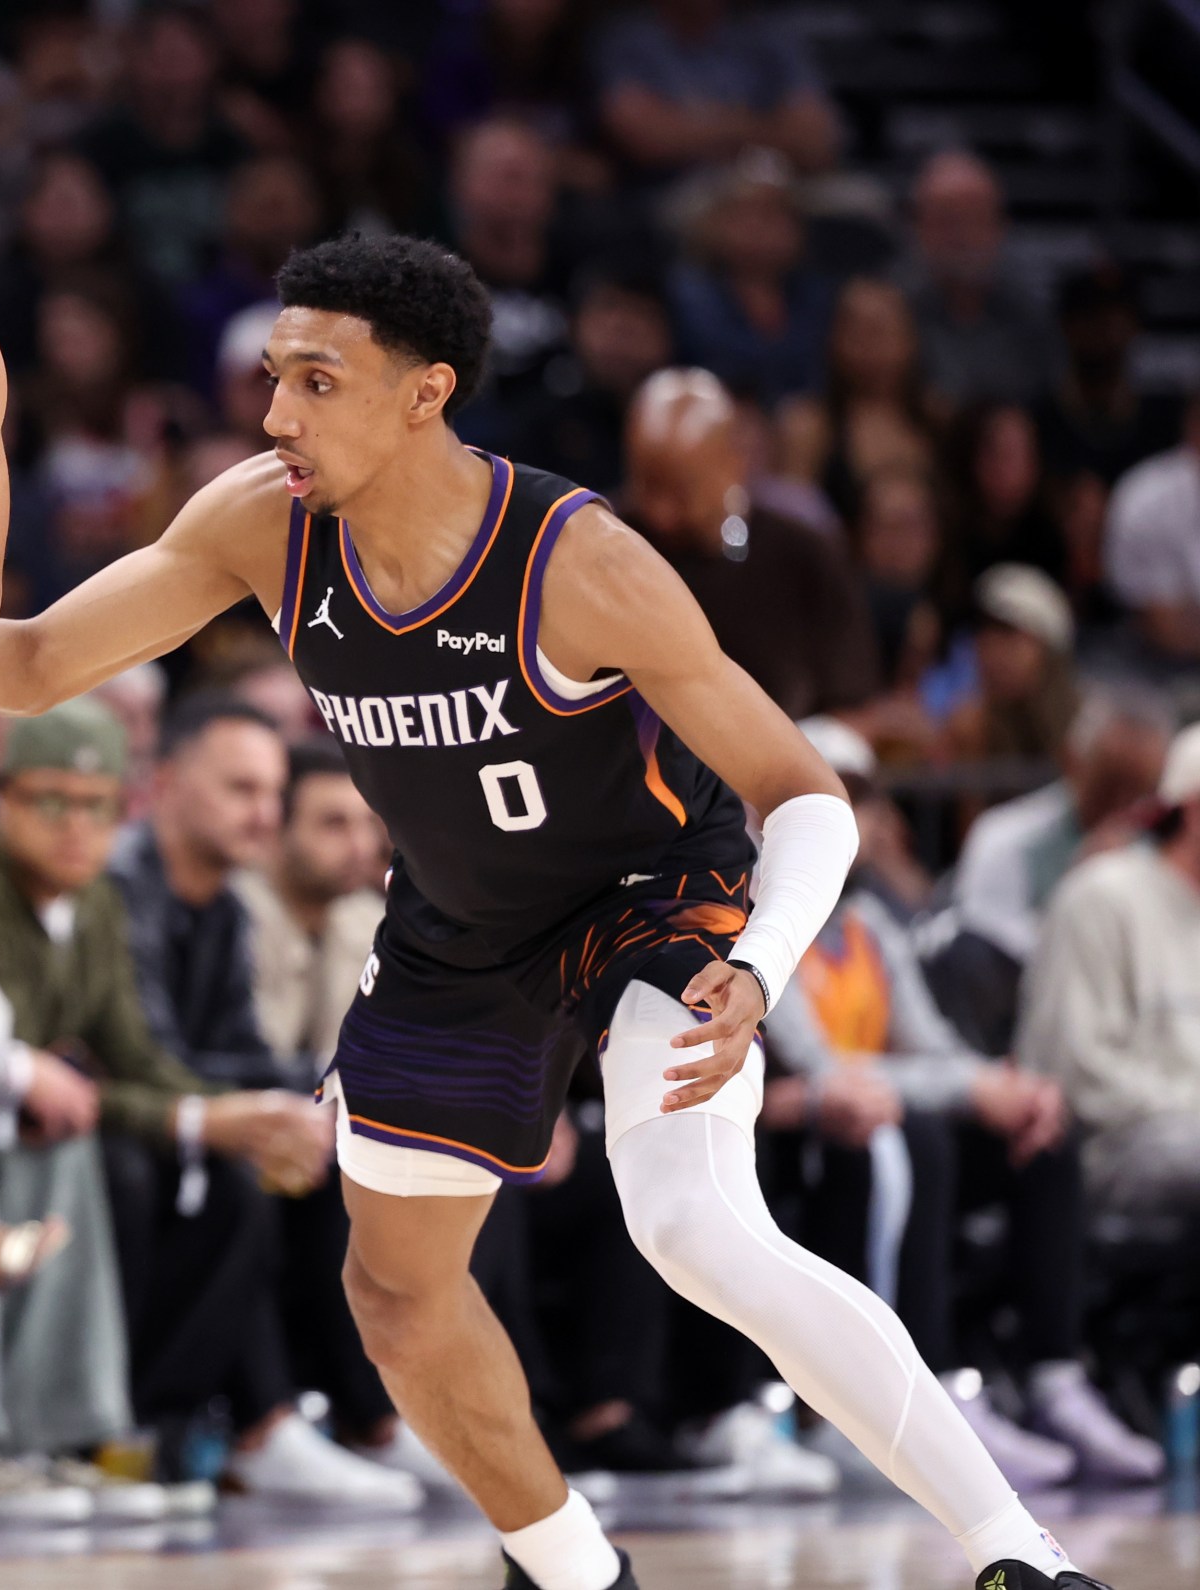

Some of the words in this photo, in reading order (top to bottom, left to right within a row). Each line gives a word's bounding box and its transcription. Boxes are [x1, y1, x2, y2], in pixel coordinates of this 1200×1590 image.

[436, 629, 506, 655] PayPal
[309, 678, 521, 747] PHOENIX
[478, 760, 548, 832] 0
